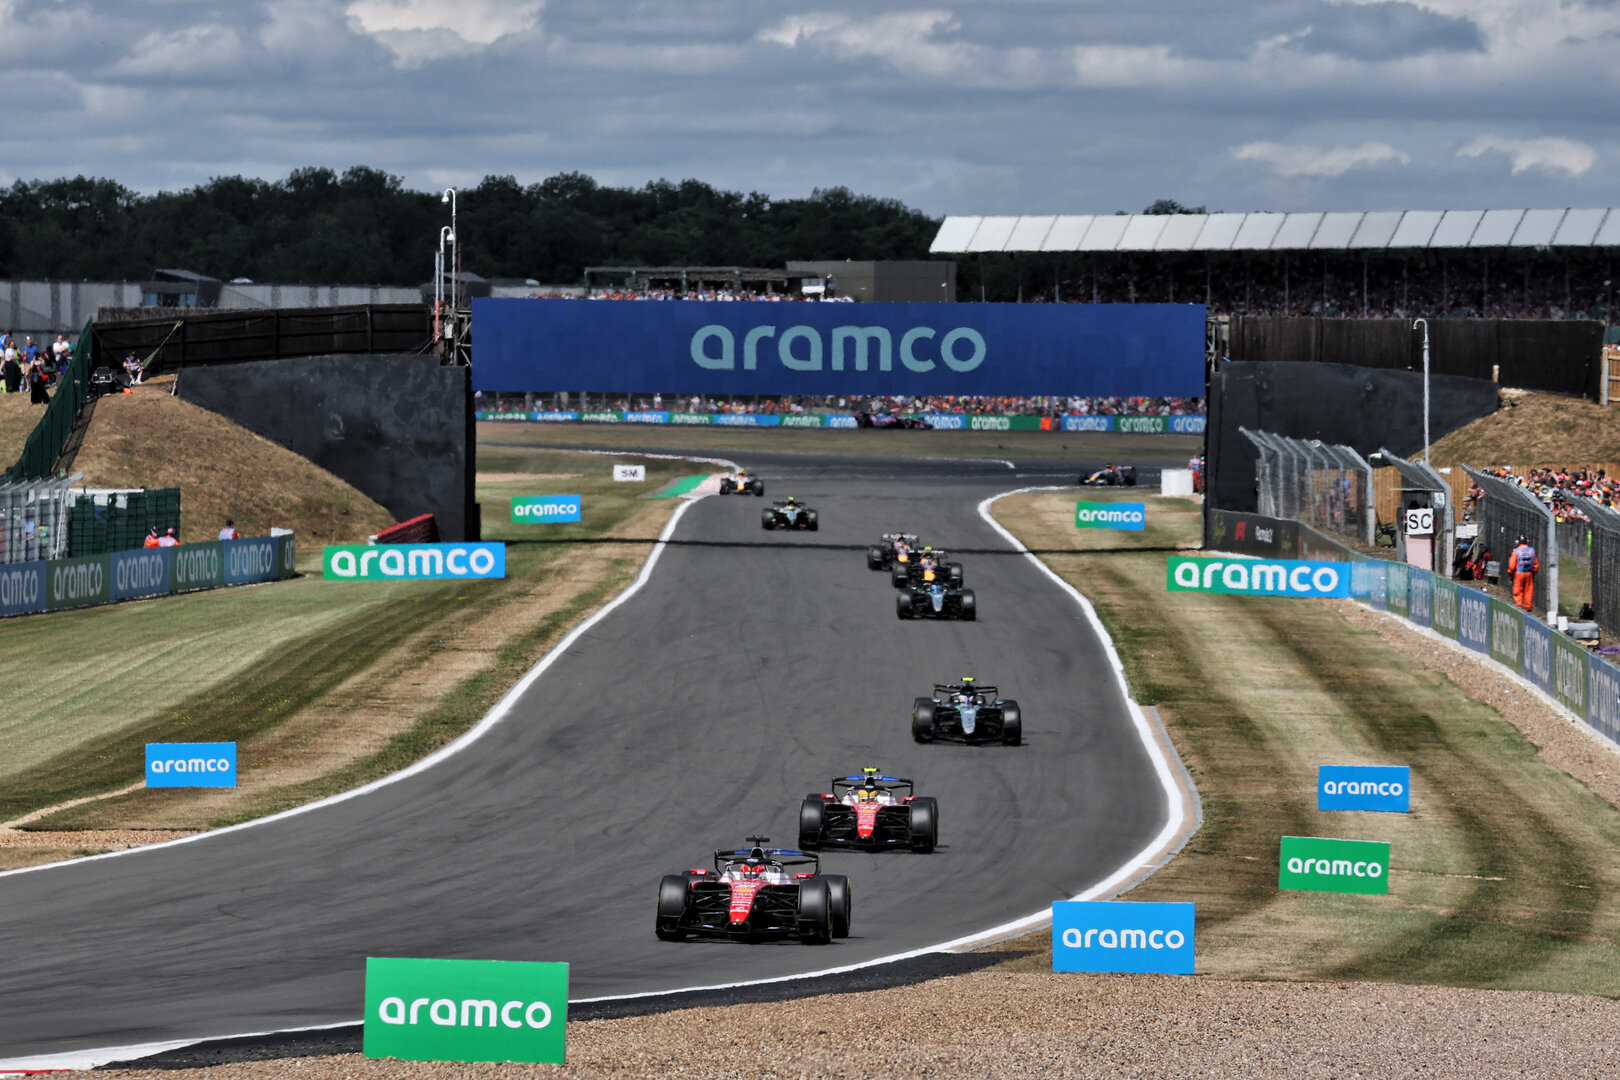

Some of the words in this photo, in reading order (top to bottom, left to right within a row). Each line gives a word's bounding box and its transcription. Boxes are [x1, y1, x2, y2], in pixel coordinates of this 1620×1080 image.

[690, 324, 987, 373] aramco
[514, 502, 577, 516] aramco
[1078, 509, 1143, 523] aramco
[1408, 513, 1432, 530] SC
[117, 553, 163, 591] aramco
[176, 548, 218, 583] aramco
[230, 543, 273, 576] aramco
[330, 548, 495, 577] aramco
[0, 569, 39, 606] amco
[53, 562, 103, 601] aramco
[1174, 562, 1339, 593] aramco
[151, 758, 230, 773] aramco
[1323, 781, 1404, 796] aramco
[1287, 857, 1382, 878] aramco
[1062, 928, 1185, 949] aramco
[378, 996, 552, 1029] aramco
